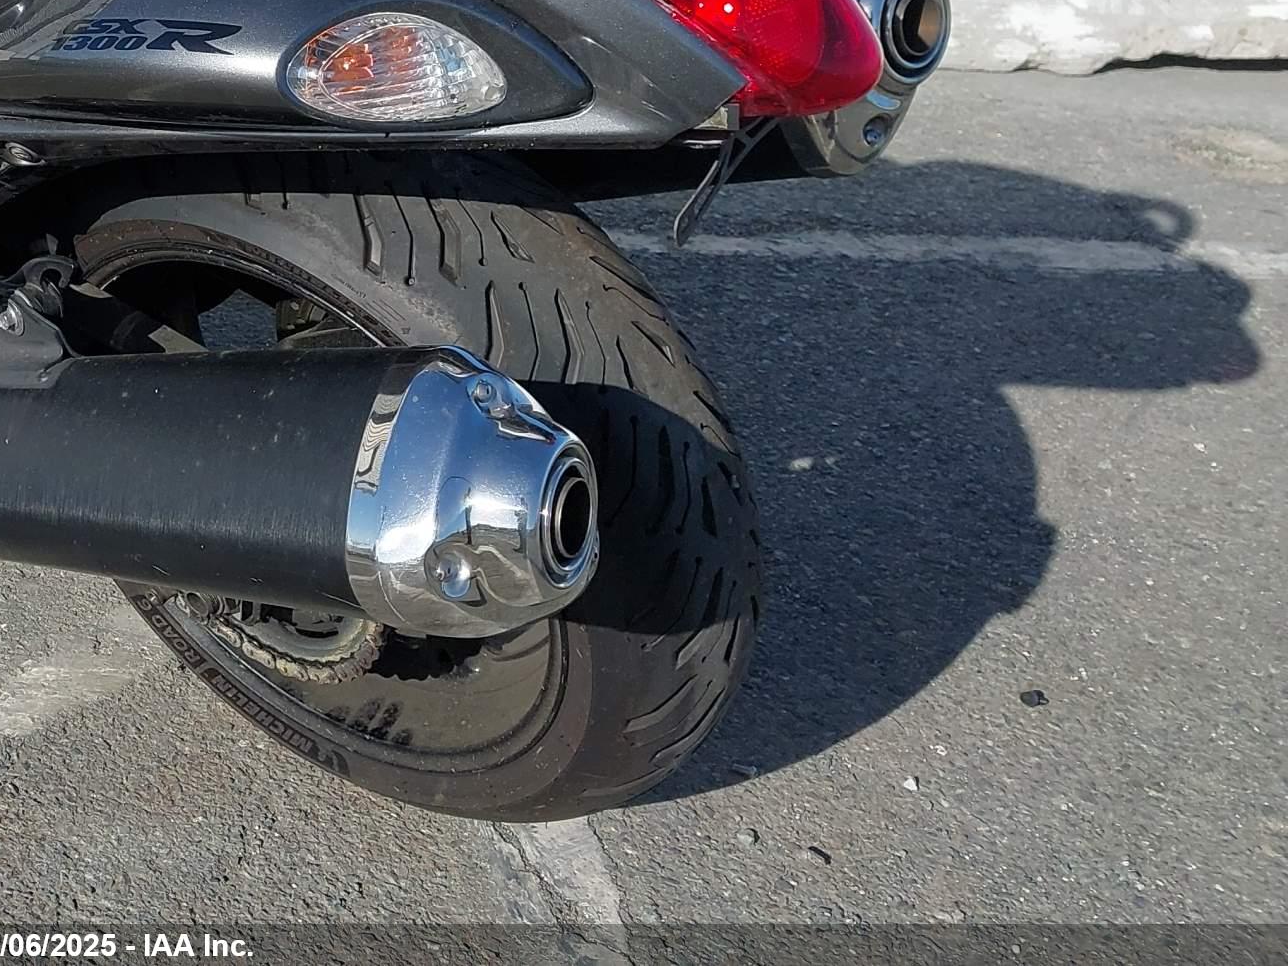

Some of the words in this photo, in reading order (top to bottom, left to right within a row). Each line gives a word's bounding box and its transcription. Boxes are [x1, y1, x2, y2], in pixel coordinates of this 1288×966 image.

[50, 35, 149, 51] 1300
[62, 18, 150, 35] GSX
[150, 613, 201, 663] ROAD
[213, 675, 313, 752] MICHELIN
